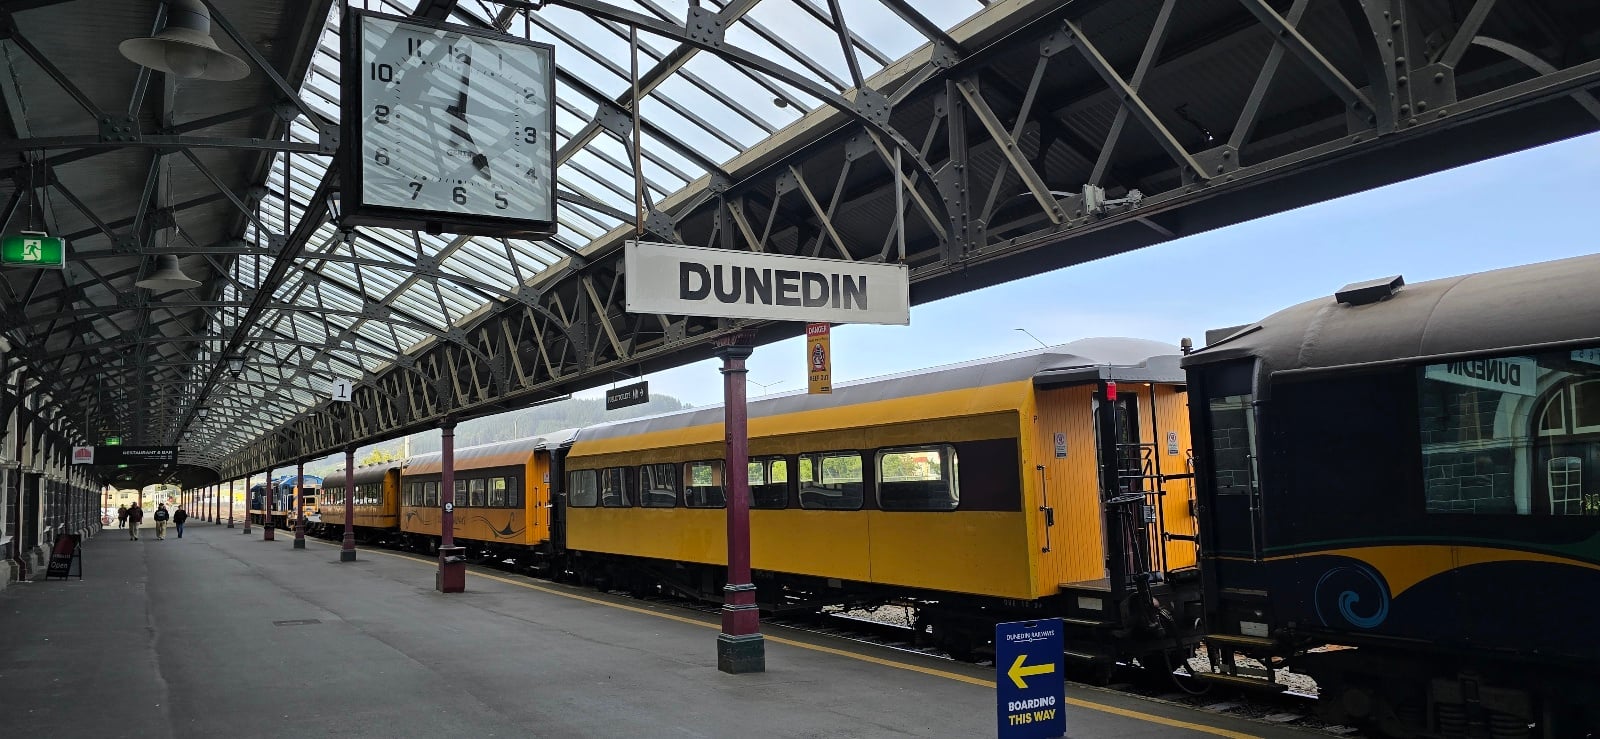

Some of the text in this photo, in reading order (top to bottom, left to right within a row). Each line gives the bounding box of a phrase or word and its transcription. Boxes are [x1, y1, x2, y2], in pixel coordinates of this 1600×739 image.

[408, 38, 422, 57] 11
[449, 45, 471, 69] 12
[498, 53, 503, 71] 1
[371, 62, 393, 82] 10
[523, 87, 537, 105] 2
[375, 104, 390, 124] 9
[524, 126, 537, 144] 3
[375, 147, 390, 167] 8
[524, 167, 538, 184] 4
[409, 181, 423, 200] 7
[452, 186, 467, 205] 6
[494, 191, 508, 210] 5
[679, 261, 868, 311] DUNEDIN
[808, 324, 827, 335] DANGER
[338, 384, 347, 398] 1
[1033, 415, 1038, 424] P
[51, 561, 68, 569] Open
[1006, 629, 1055, 641] DUNEDIN RAILWAYS
[1008, 695, 1056, 712] BOARDING
[1008, 709, 1056, 727] THIS WAY
